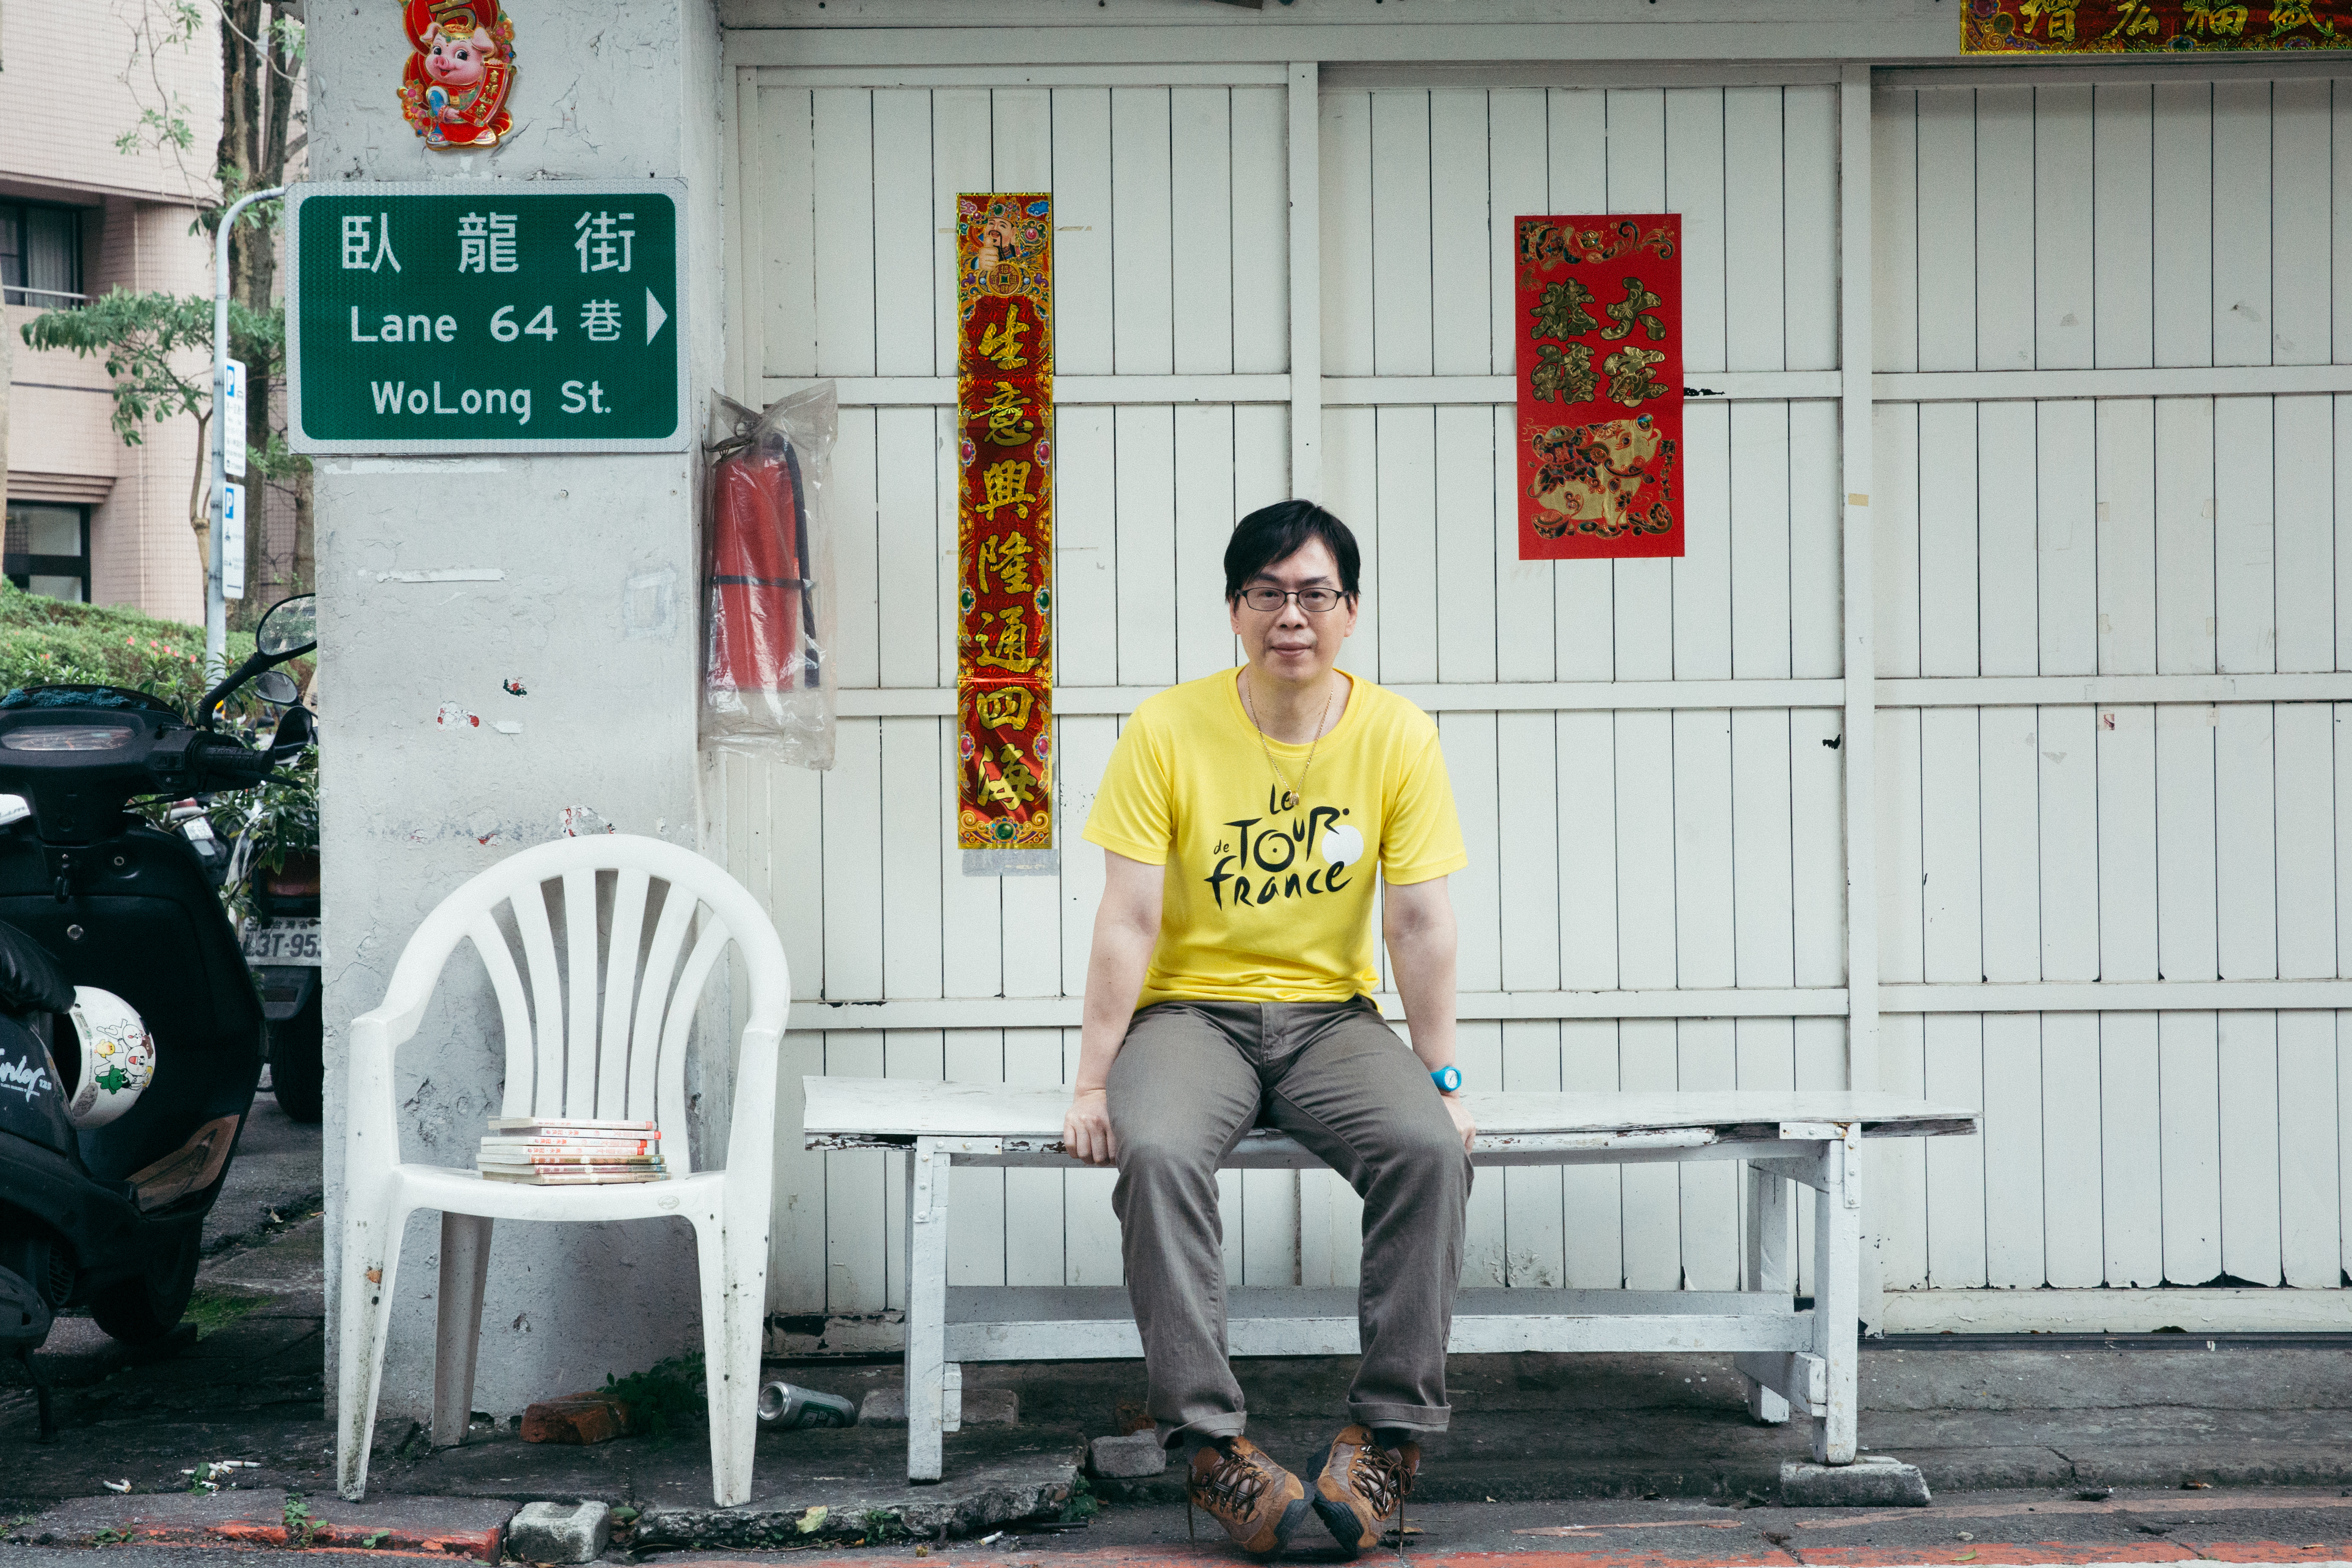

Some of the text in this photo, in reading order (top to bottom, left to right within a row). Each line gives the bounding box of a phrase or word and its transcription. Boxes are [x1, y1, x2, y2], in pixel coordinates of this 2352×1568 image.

[351, 299, 622, 342] Lane 64 巷
[371, 380, 612, 426] WoLong St.
[970, 303, 1041, 811] 生意興隆通四海
[1214, 839, 1230, 855] de
